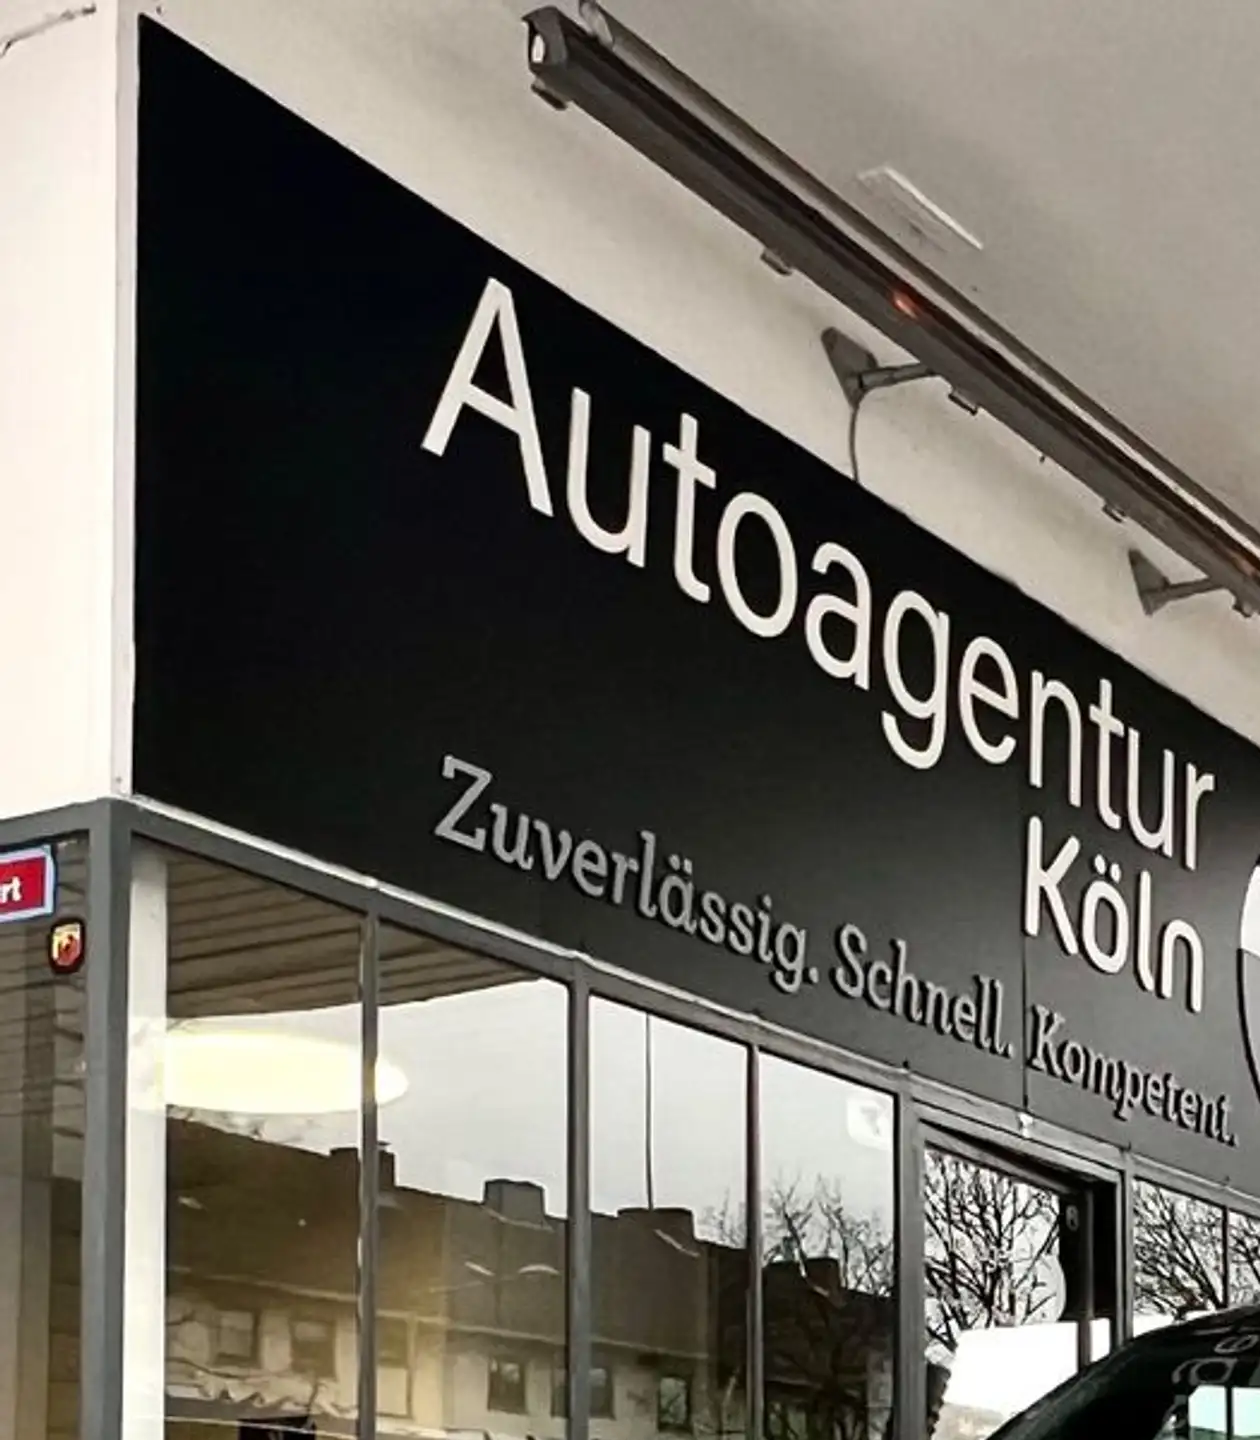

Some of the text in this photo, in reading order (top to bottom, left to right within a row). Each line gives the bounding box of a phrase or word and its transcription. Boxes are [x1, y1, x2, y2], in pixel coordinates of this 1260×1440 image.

[421, 276, 1215, 872] Autoagentur
[0, 875, 23, 904] rt
[434, 754, 1240, 1147] Zuverlässig. Schnell. Kompetent.
[1022, 815, 1205, 1014] Köln
